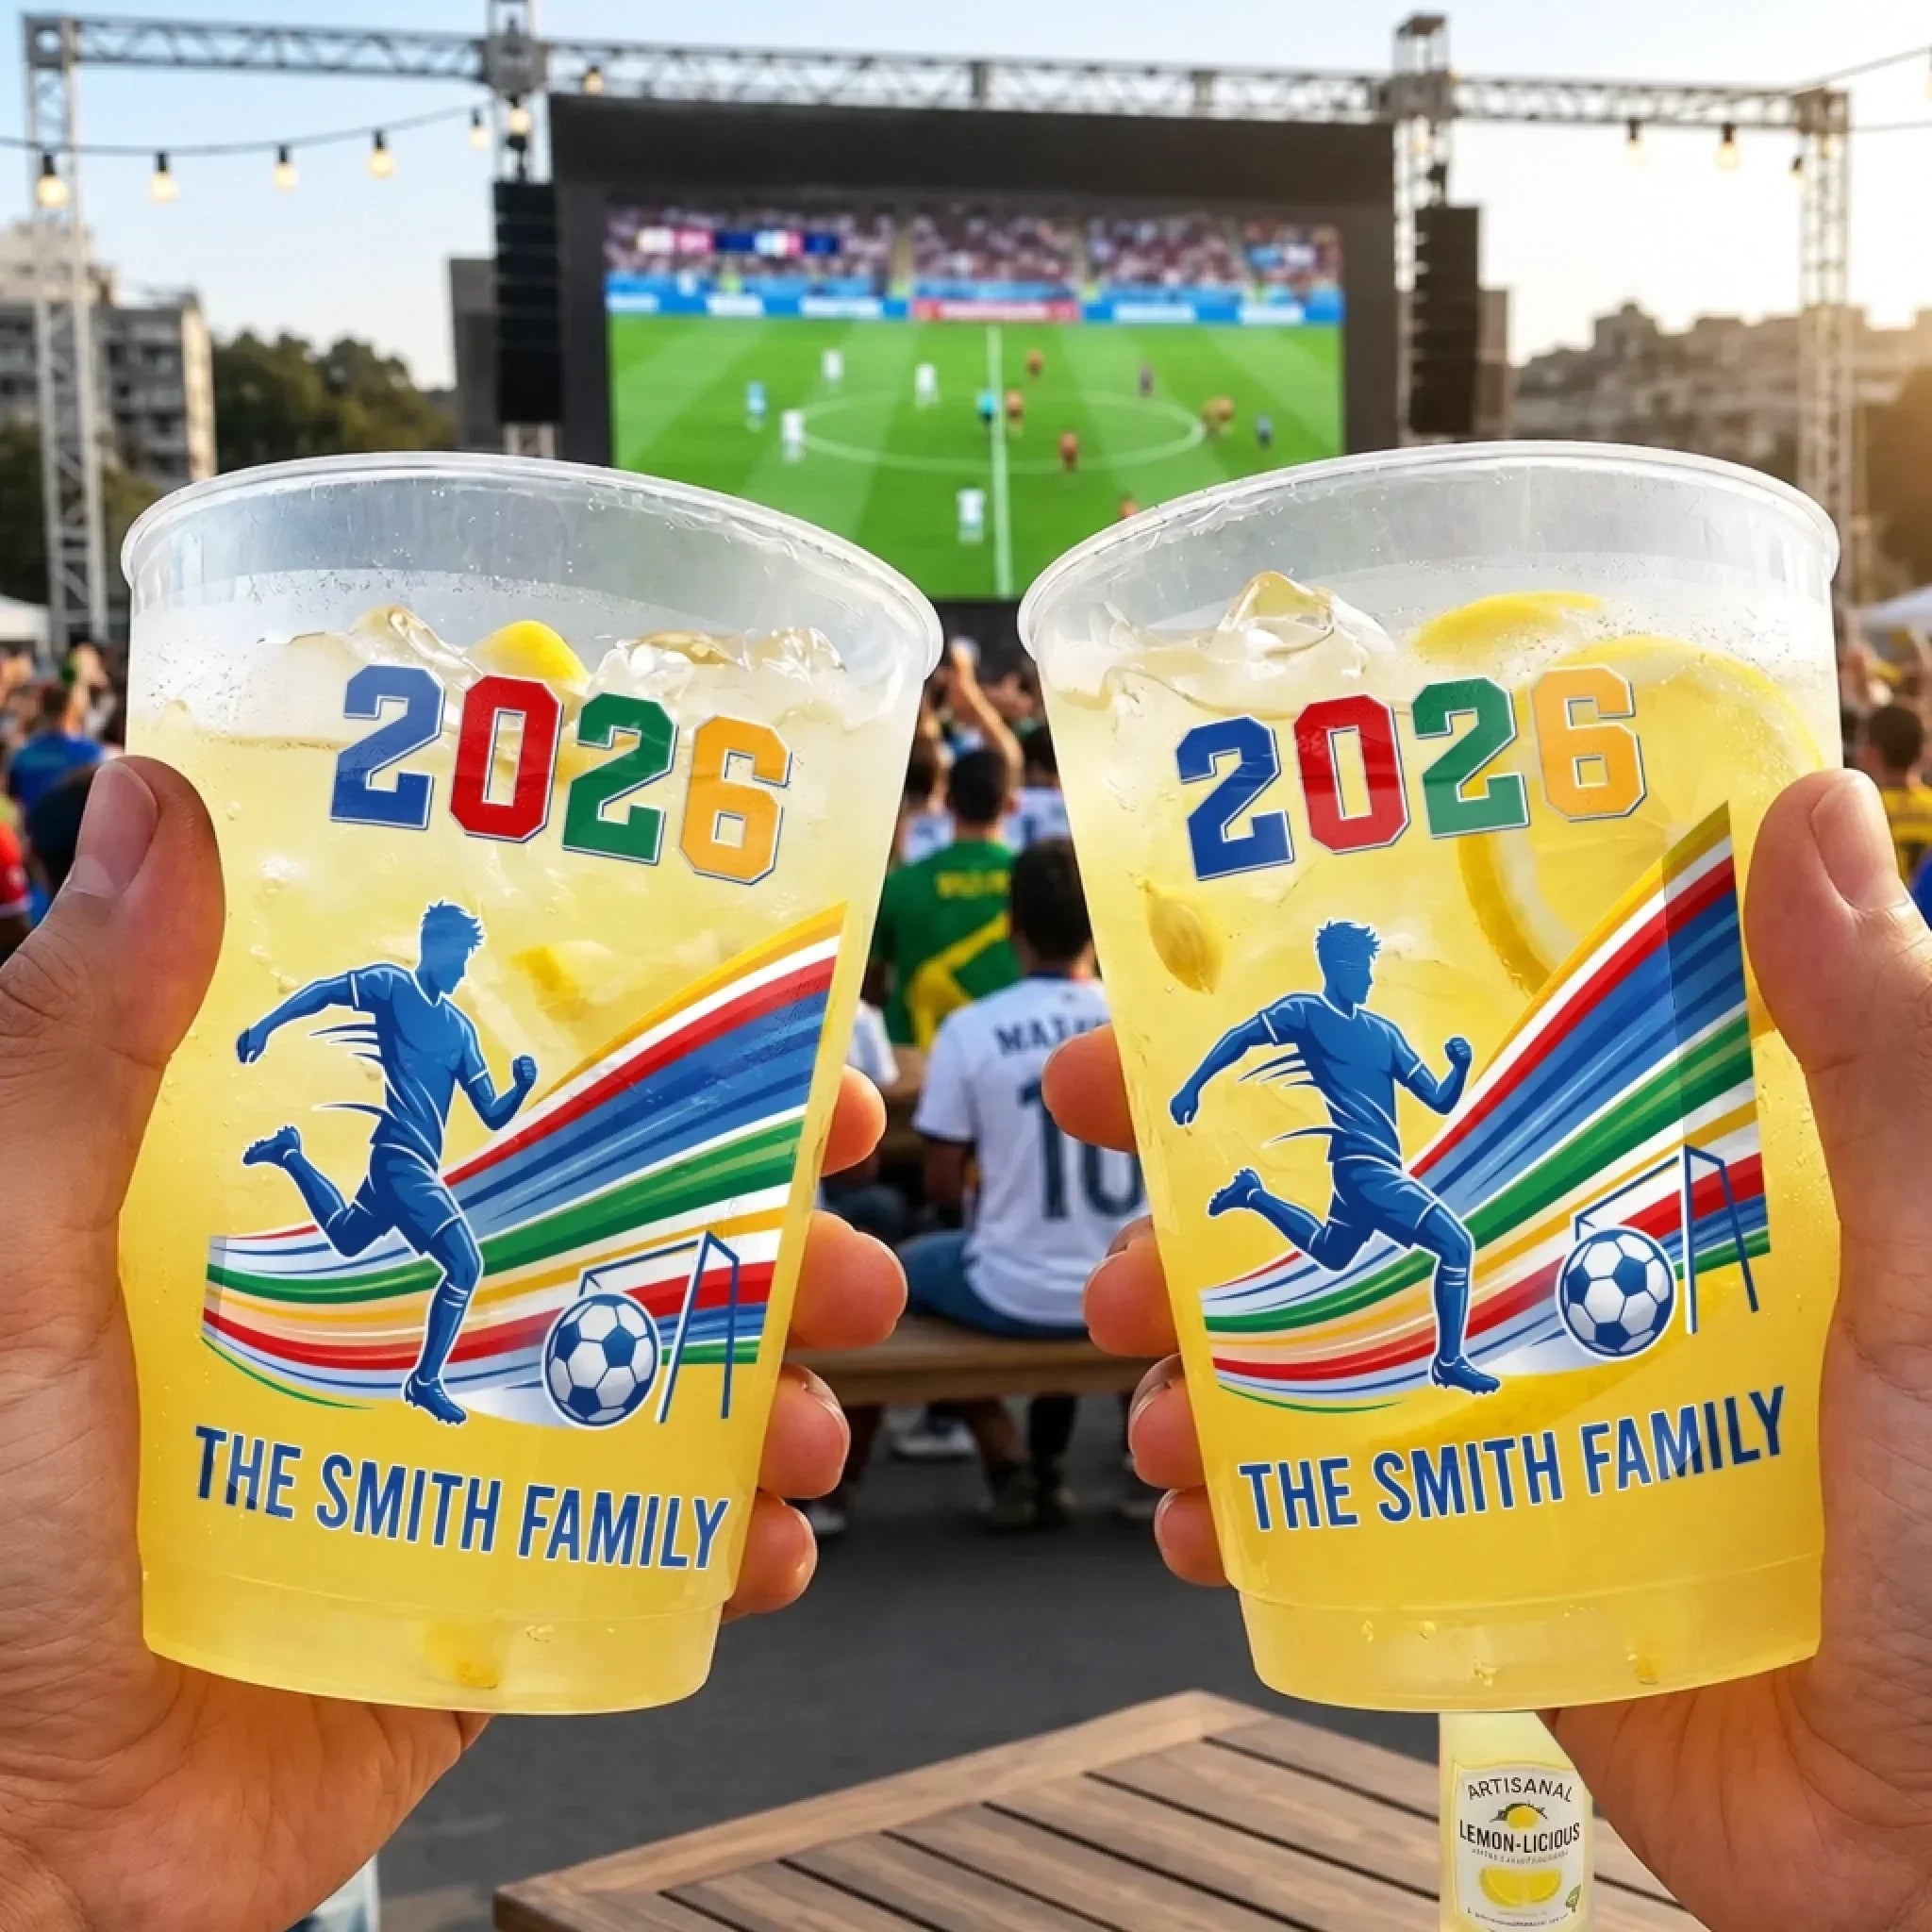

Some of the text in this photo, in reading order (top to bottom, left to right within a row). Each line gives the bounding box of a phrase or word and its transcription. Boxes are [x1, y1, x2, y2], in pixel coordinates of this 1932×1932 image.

[330, 664, 793, 885] 2026
[1175, 664, 1647, 882] 2026
[195, 1424, 730, 1570] THE SMITH FAMILY
[1238, 1386, 1785, 1532] THE SMITH FAMILY
[1459, 1820, 1580, 1854] LEMON-LICIOUS
[1467, 1777, 1573, 1802] ARTISANAL
